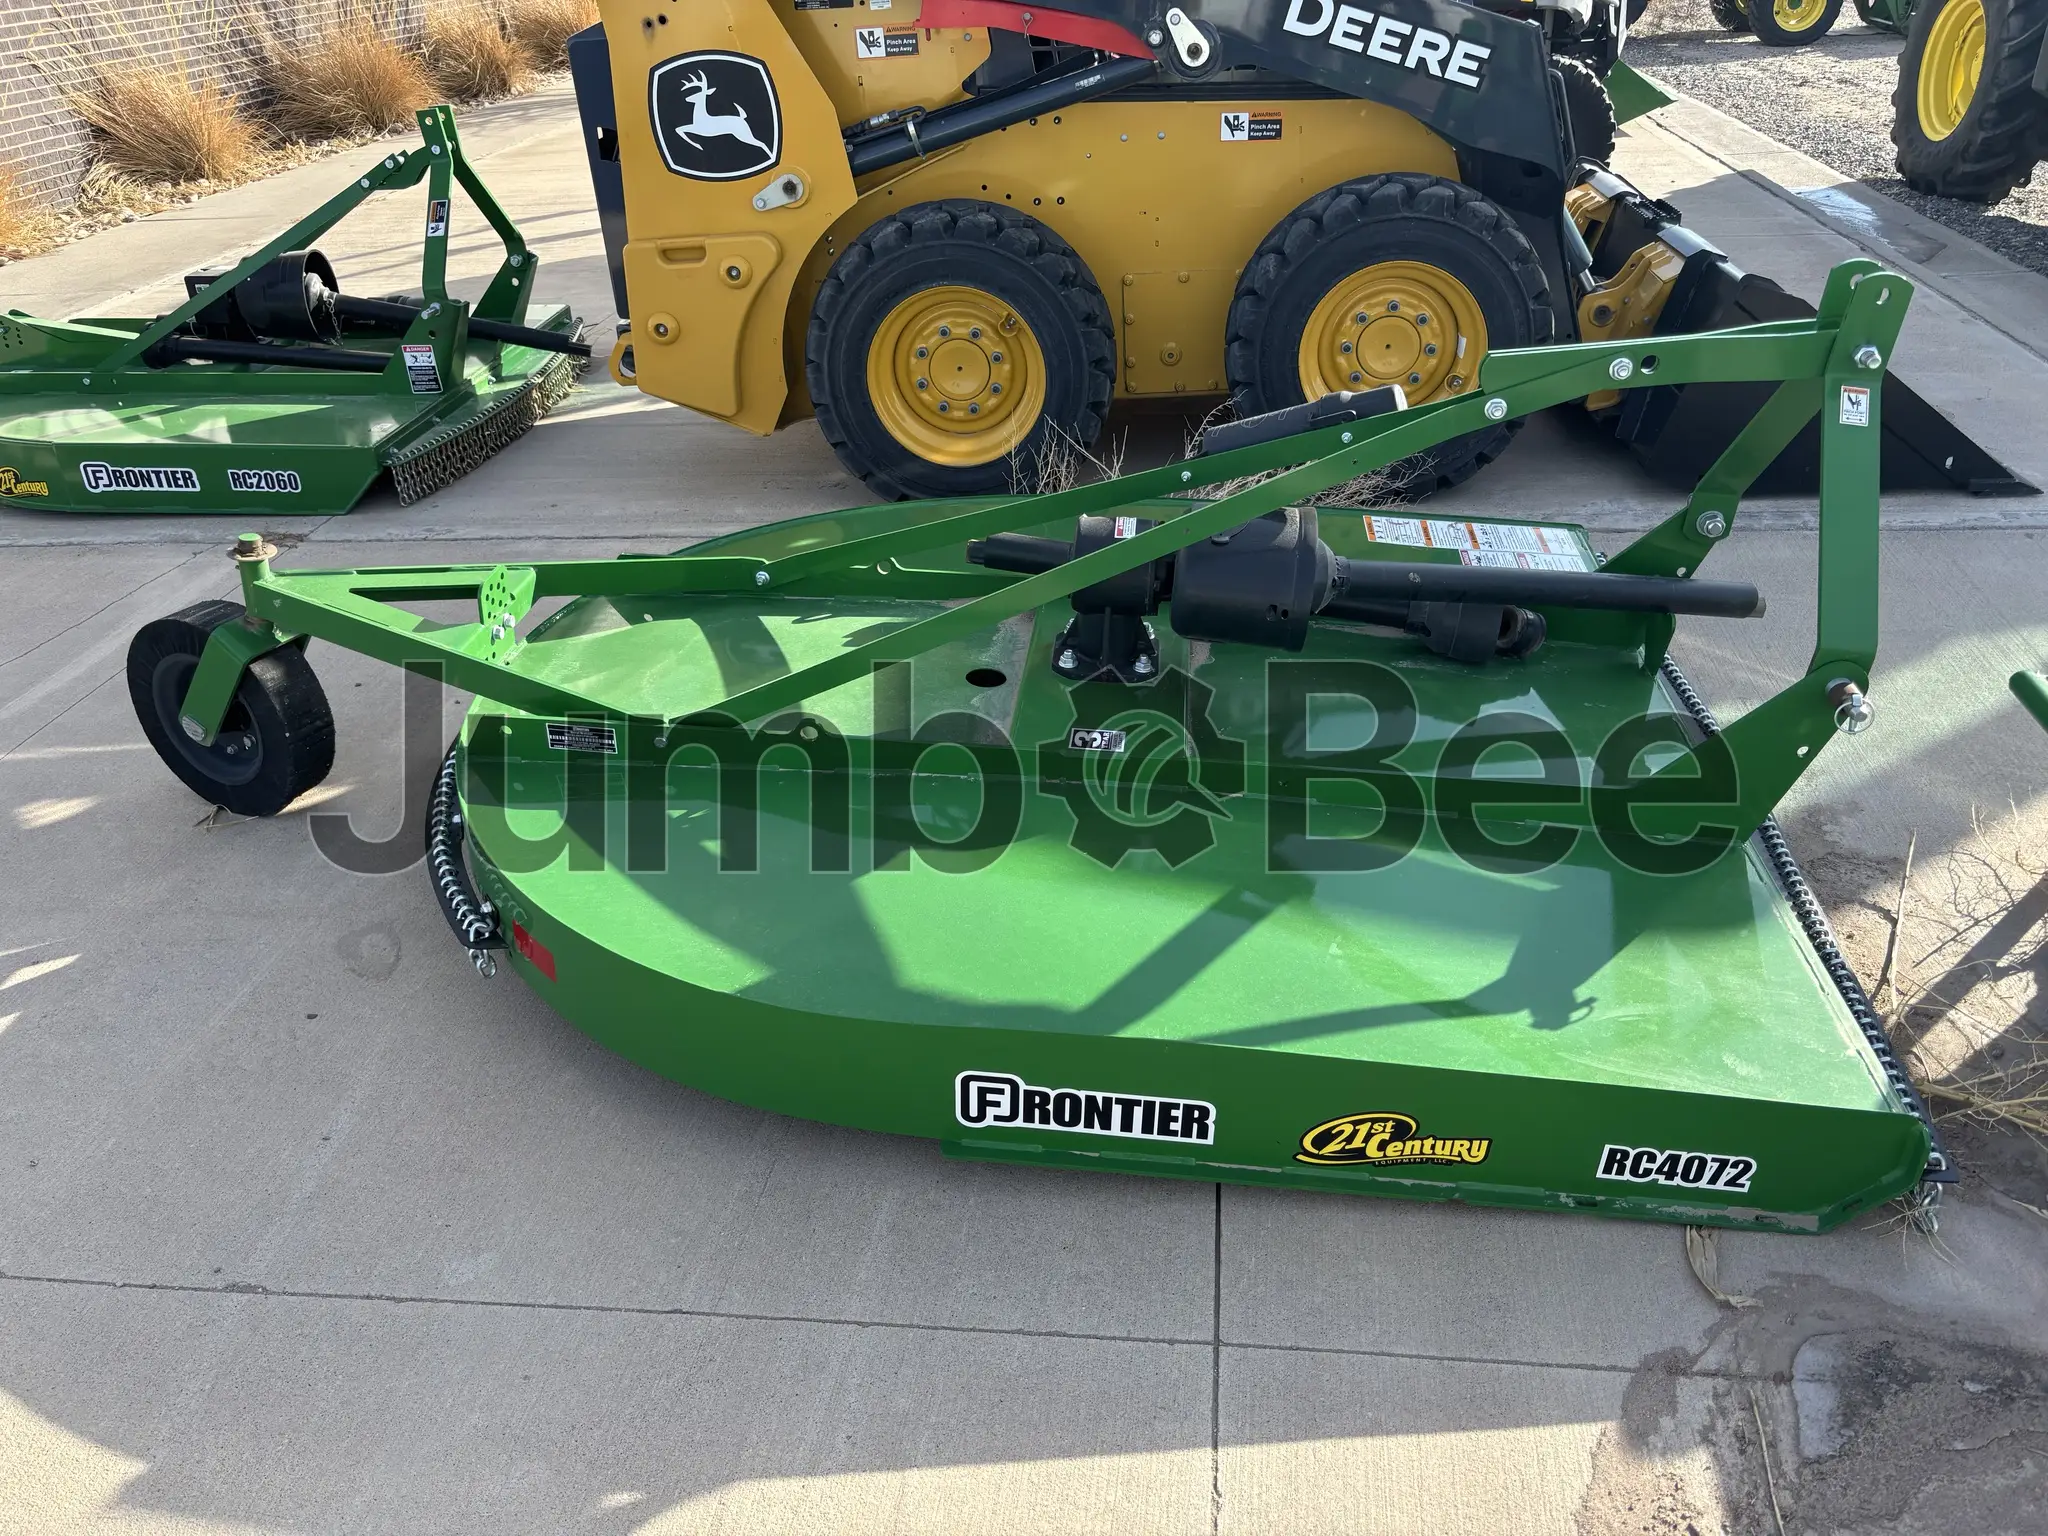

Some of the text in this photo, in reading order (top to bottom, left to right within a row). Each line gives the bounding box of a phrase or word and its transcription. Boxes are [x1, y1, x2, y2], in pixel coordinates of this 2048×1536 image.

[1283, 0, 1491, 88] DEERE
[83, 463, 197, 490] FRONTIER
[229, 469, 299, 492] RC2060
[1074, 731, 1101, 748] 3
[1101, 732, 1110, 749] YEAR
[961, 1074, 1209, 1140] FRONTIER
[1319, 1119, 1396, 1155] 21st
[1375, 1158, 1427, 1166] EQUIPMENT
[1601, 1147, 1753, 1189] RC4072
